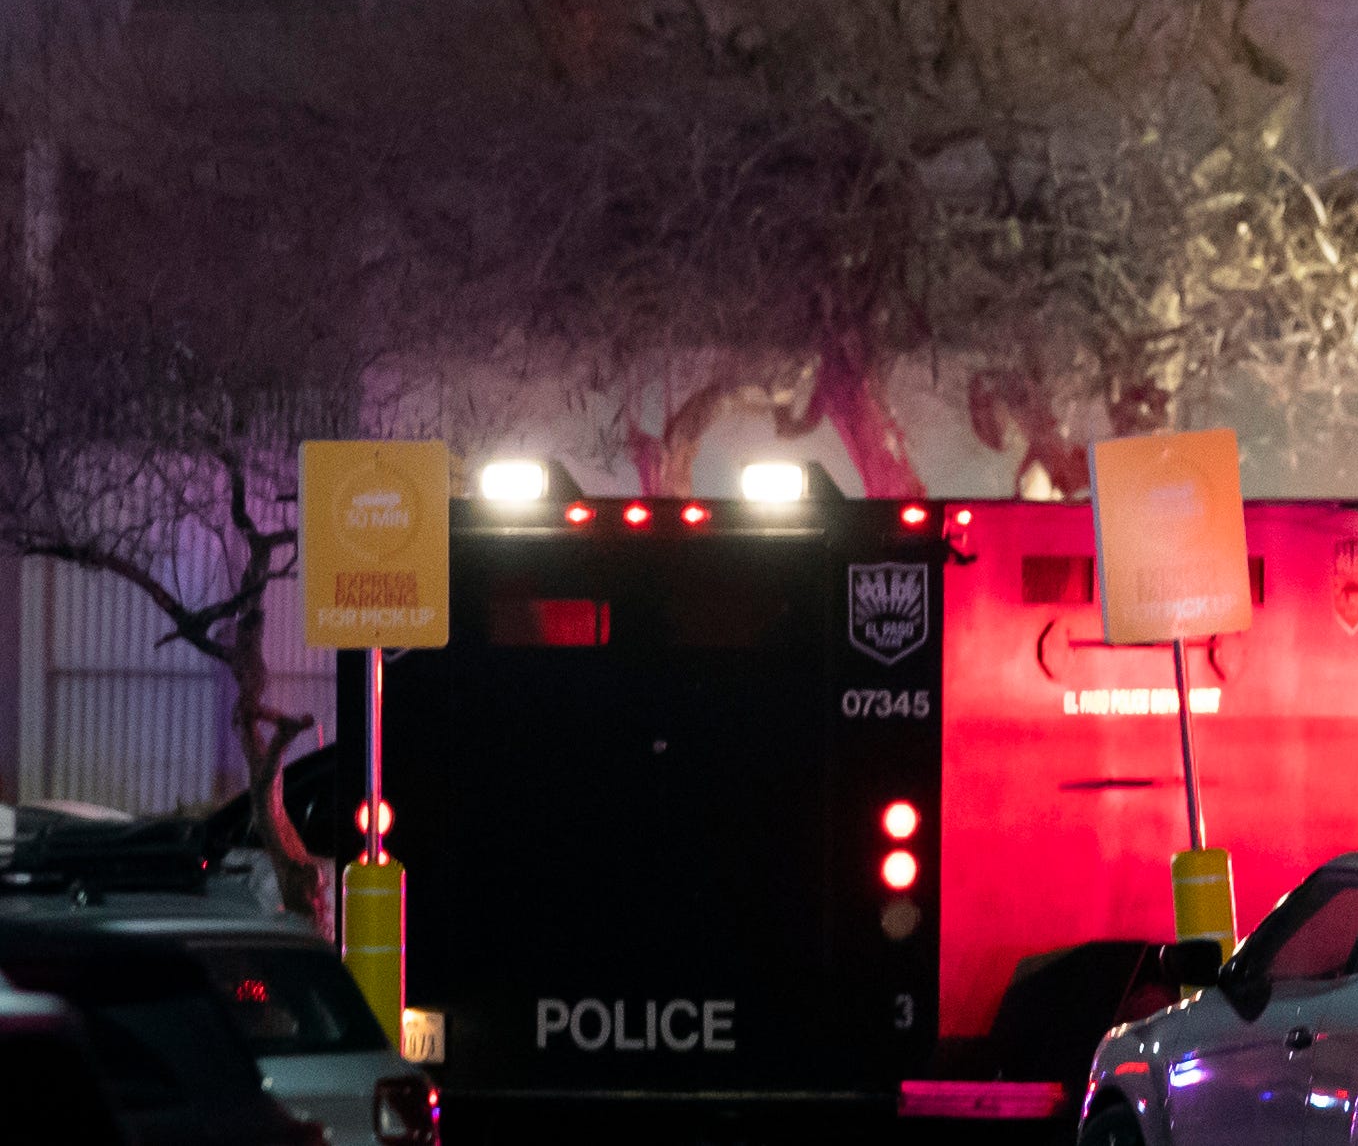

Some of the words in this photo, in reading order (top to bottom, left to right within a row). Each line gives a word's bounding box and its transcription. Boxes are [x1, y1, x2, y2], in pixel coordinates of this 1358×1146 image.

[371, 508, 411, 527] MIN
[335, 570, 418, 589] EXPRESS
[334, 588, 419, 607] PARKING
[318, 608, 357, 629] FOR
[361, 608, 405, 628] PICK
[409, 607, 437, 628] UP
[842, 689, 930, 718] 07345
[895, 993, 914, 1029] 3
[536, 998, 736, 1051] POLICE
